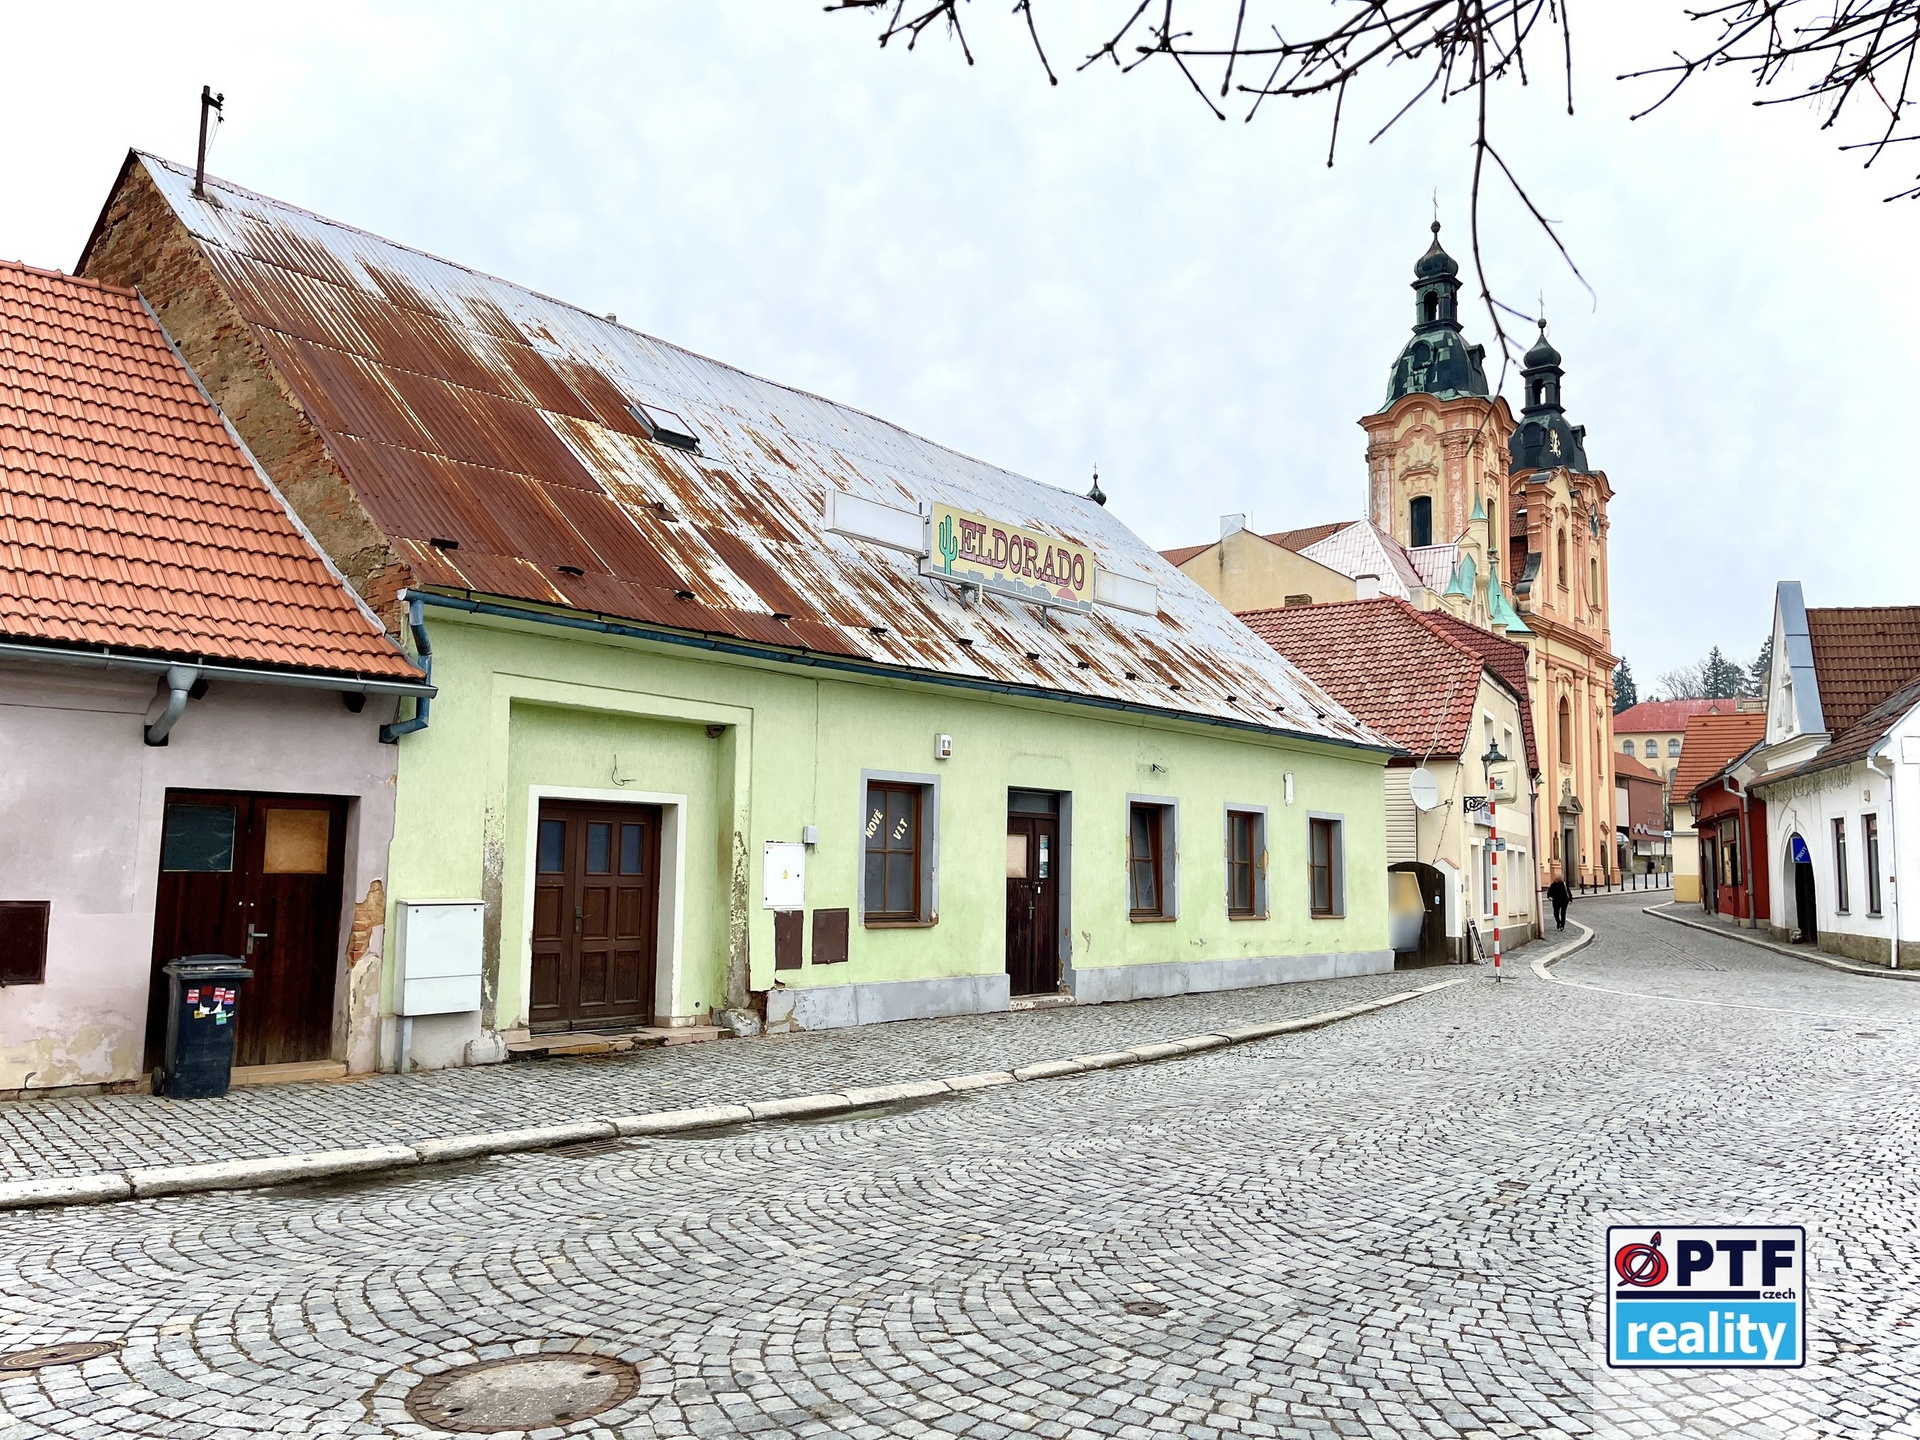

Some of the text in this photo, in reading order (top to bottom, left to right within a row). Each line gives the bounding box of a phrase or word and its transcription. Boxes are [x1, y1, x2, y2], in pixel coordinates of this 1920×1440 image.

[958, 518, 1085, 591] ELDORADO
[865, 808, 908, 841] NOVÉ VLT
